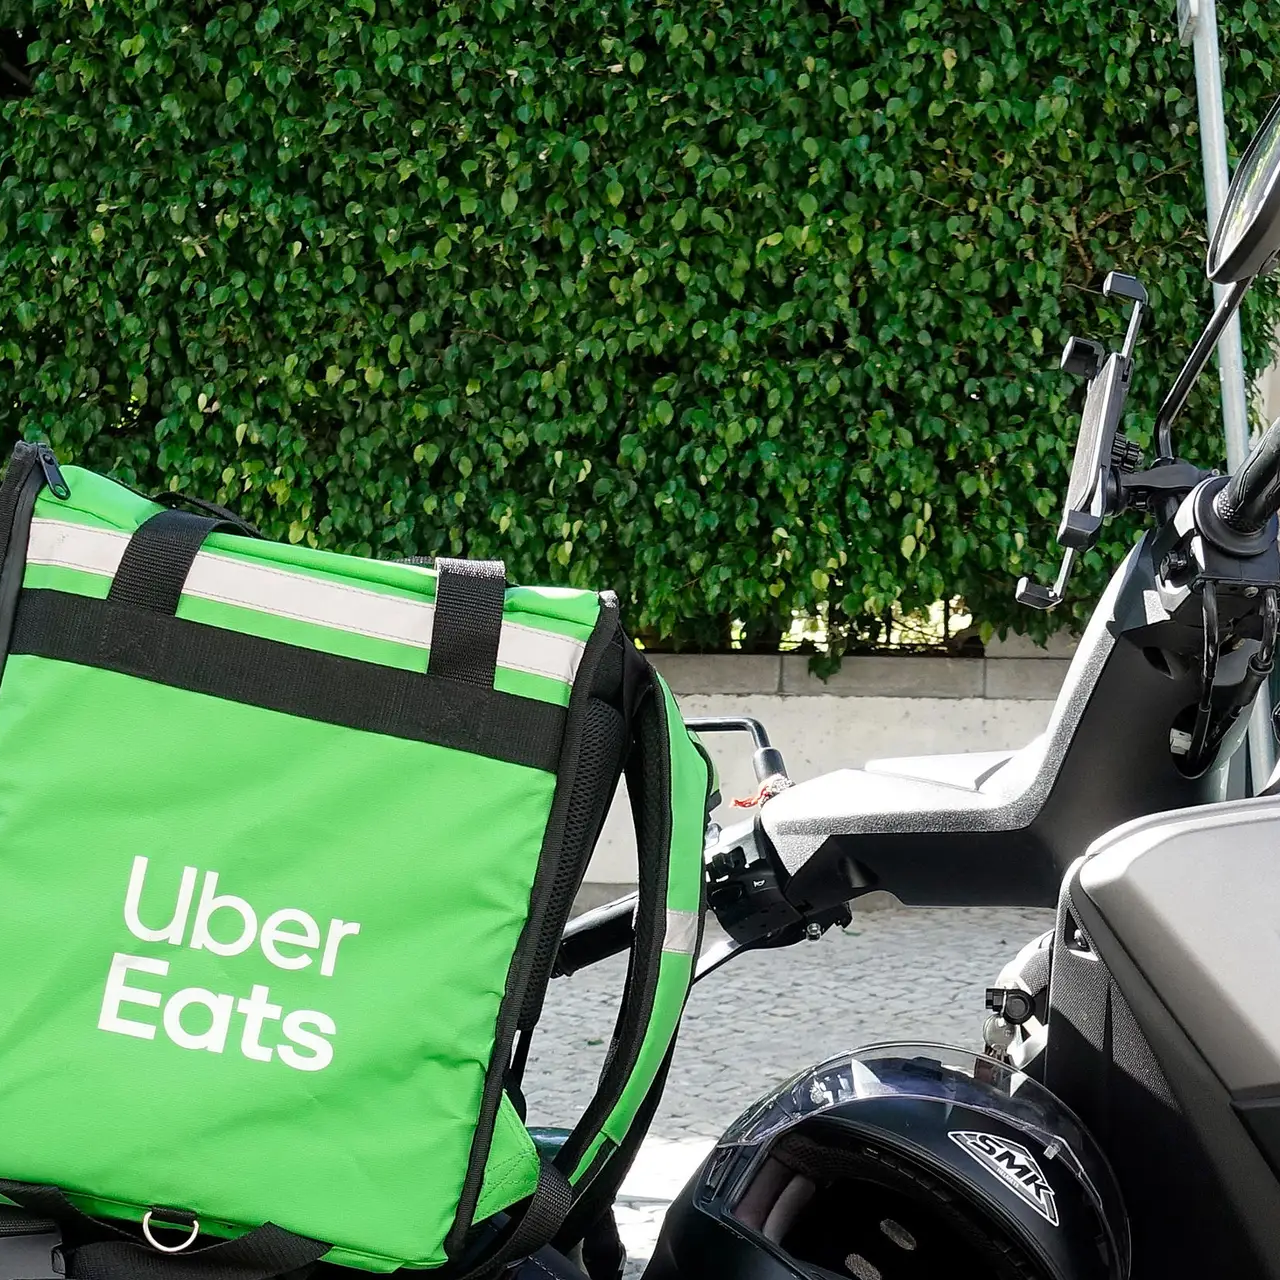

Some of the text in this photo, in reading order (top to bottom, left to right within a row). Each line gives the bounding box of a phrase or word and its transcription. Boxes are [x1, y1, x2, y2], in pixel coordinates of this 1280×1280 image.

[124, 855, 361, 977] Uber
[97, 952, 336, 1071] Eats
[967, 1134, 1052, 1202] SMK
